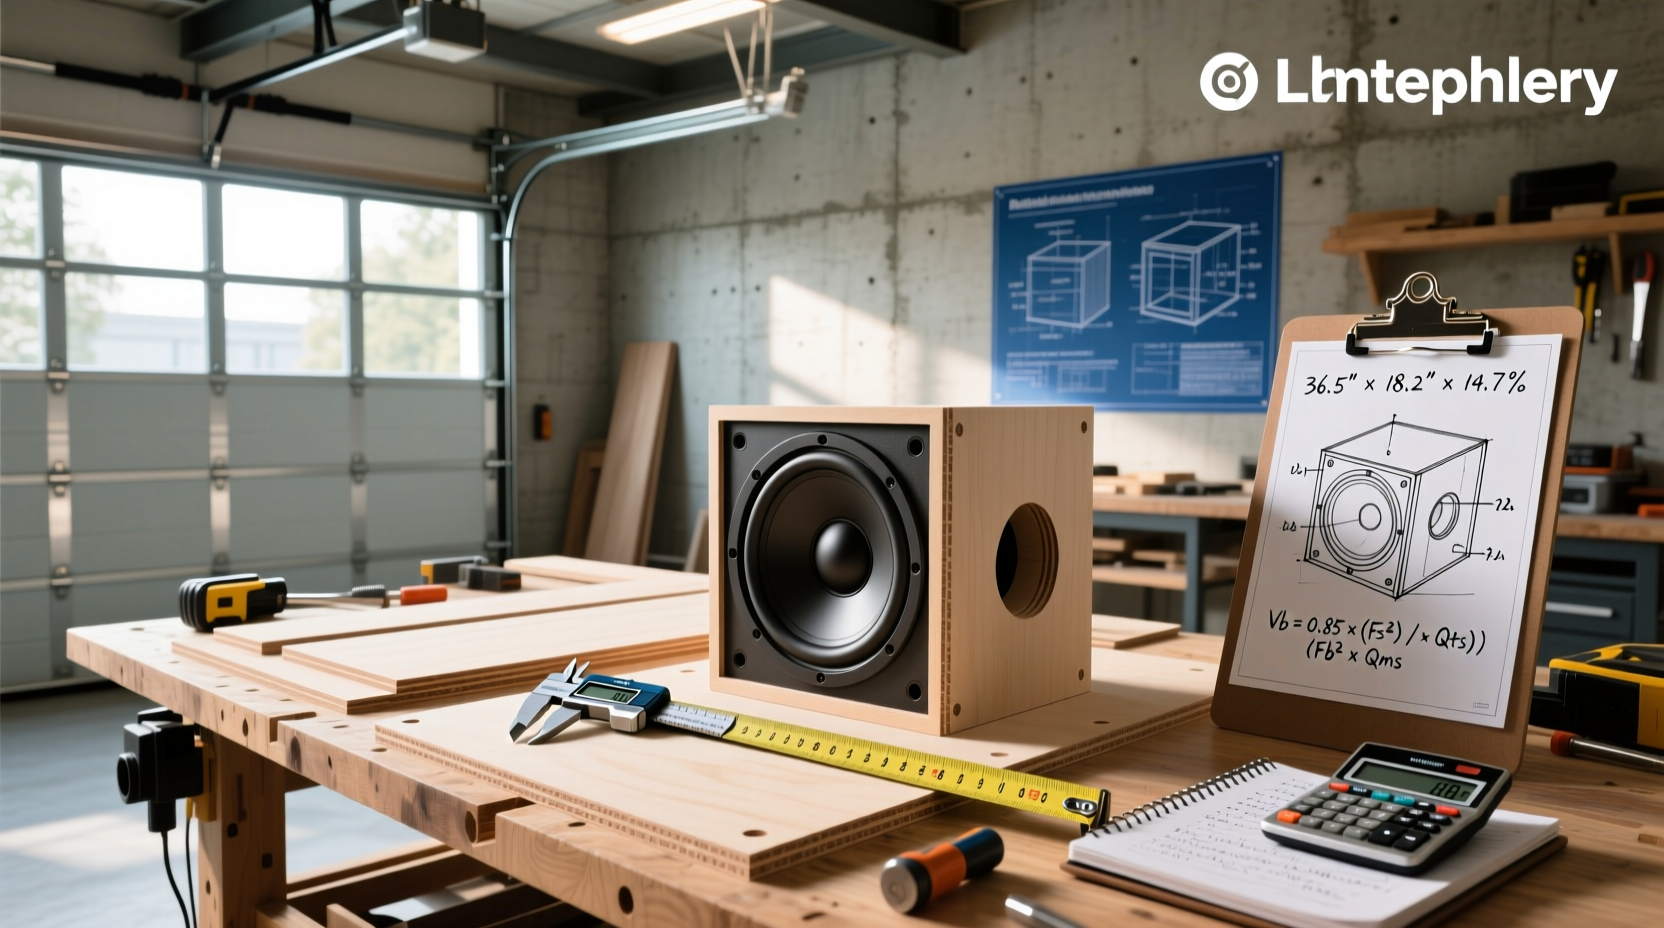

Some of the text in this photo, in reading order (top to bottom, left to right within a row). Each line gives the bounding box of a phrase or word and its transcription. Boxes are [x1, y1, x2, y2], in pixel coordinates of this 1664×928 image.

[1464, 369, 1526, 395] 14.7%
[1269, 609, 1289, 631] Vb
[1293, 619, 1303, 628] =
[1306, 616, 1346, 636] 0.85
[1364, 647, 1402, 670] Qms
